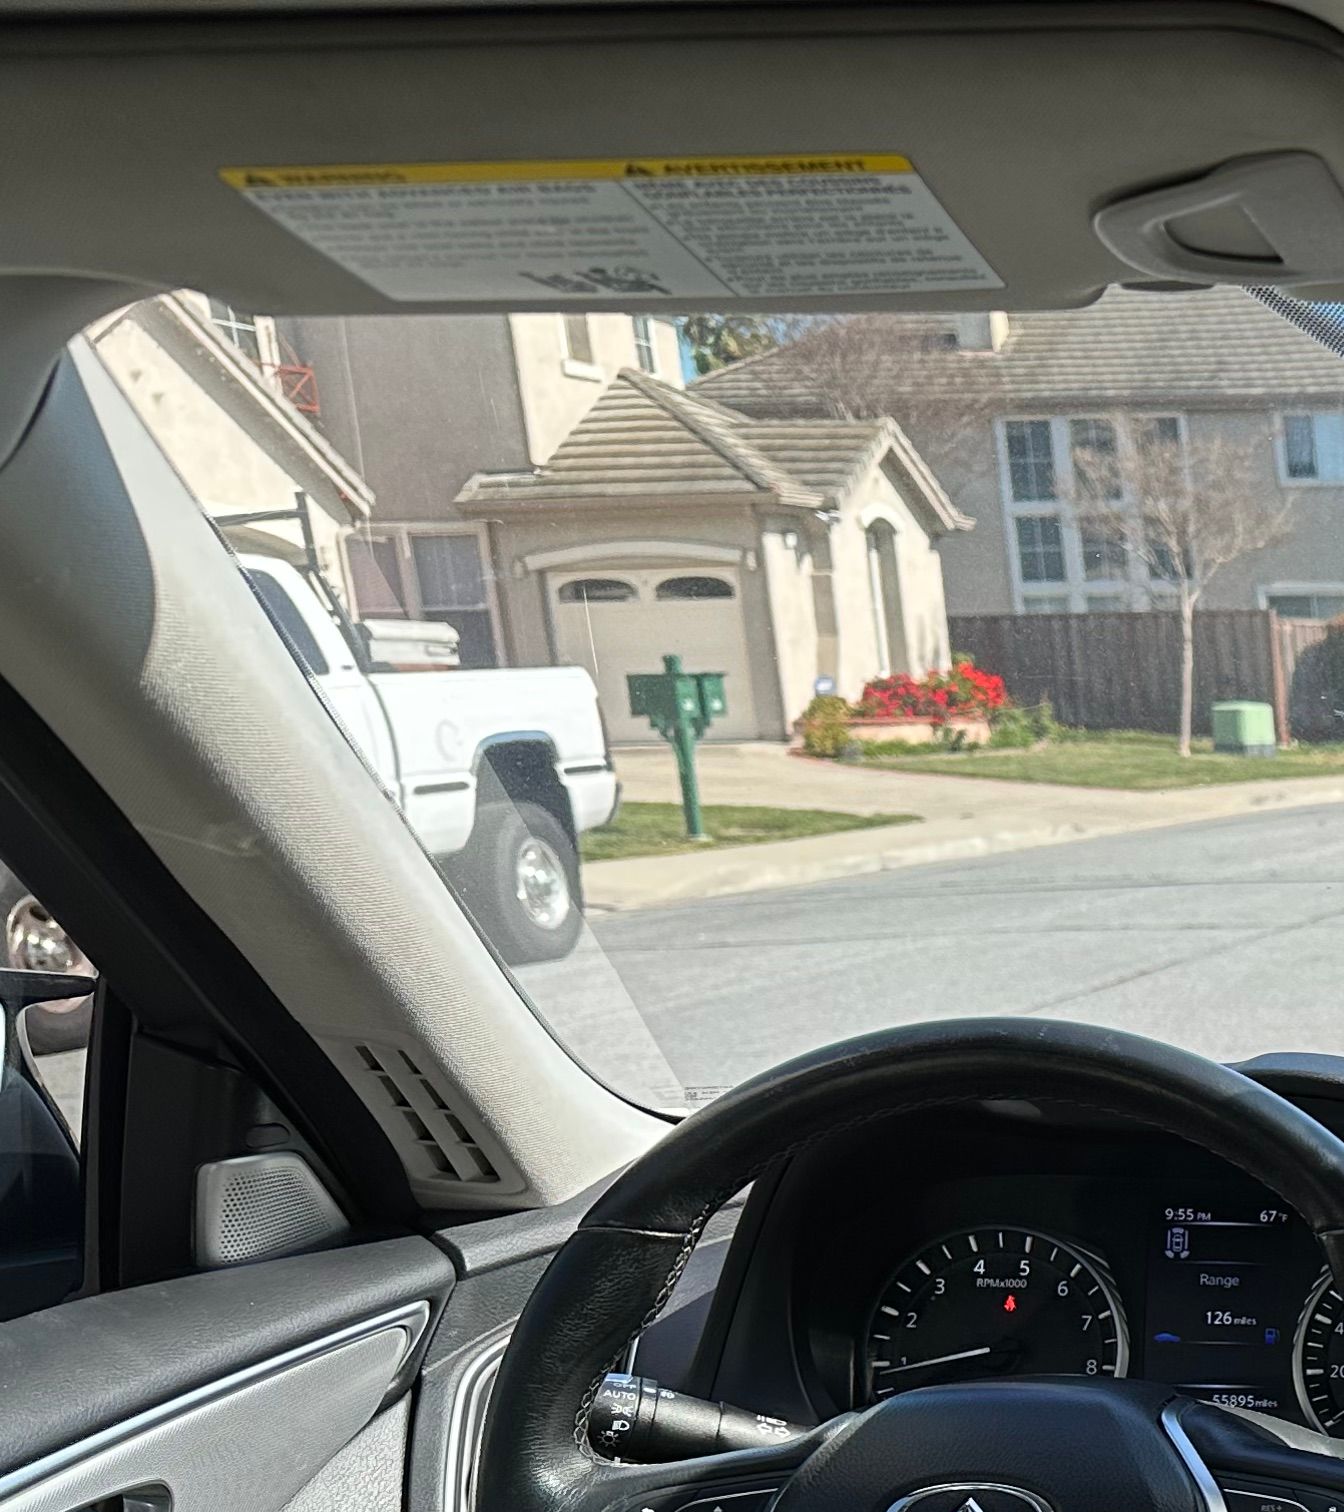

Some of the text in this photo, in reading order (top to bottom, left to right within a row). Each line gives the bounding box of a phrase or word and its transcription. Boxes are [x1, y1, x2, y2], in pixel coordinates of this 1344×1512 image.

[1165, 1208, 1194, 1221] 9:55
[973, 1259, 986, 1276] 4
[1019, 1259, 1031, 1277] 5
[934, 1278, 946, 1295] 3
[1057, 1280, 1069, 1297] 6
[1200, 1273, 1241, 1289] Range
[906, 1312, 918, 1329] 2
[1081, 1315, 1093, 1332] 7
[1205, 1310, 1233, 1325] 126
[1086, 1359, 1099, 1376] 8
[602, 1389, 636, 1401] AUTO
